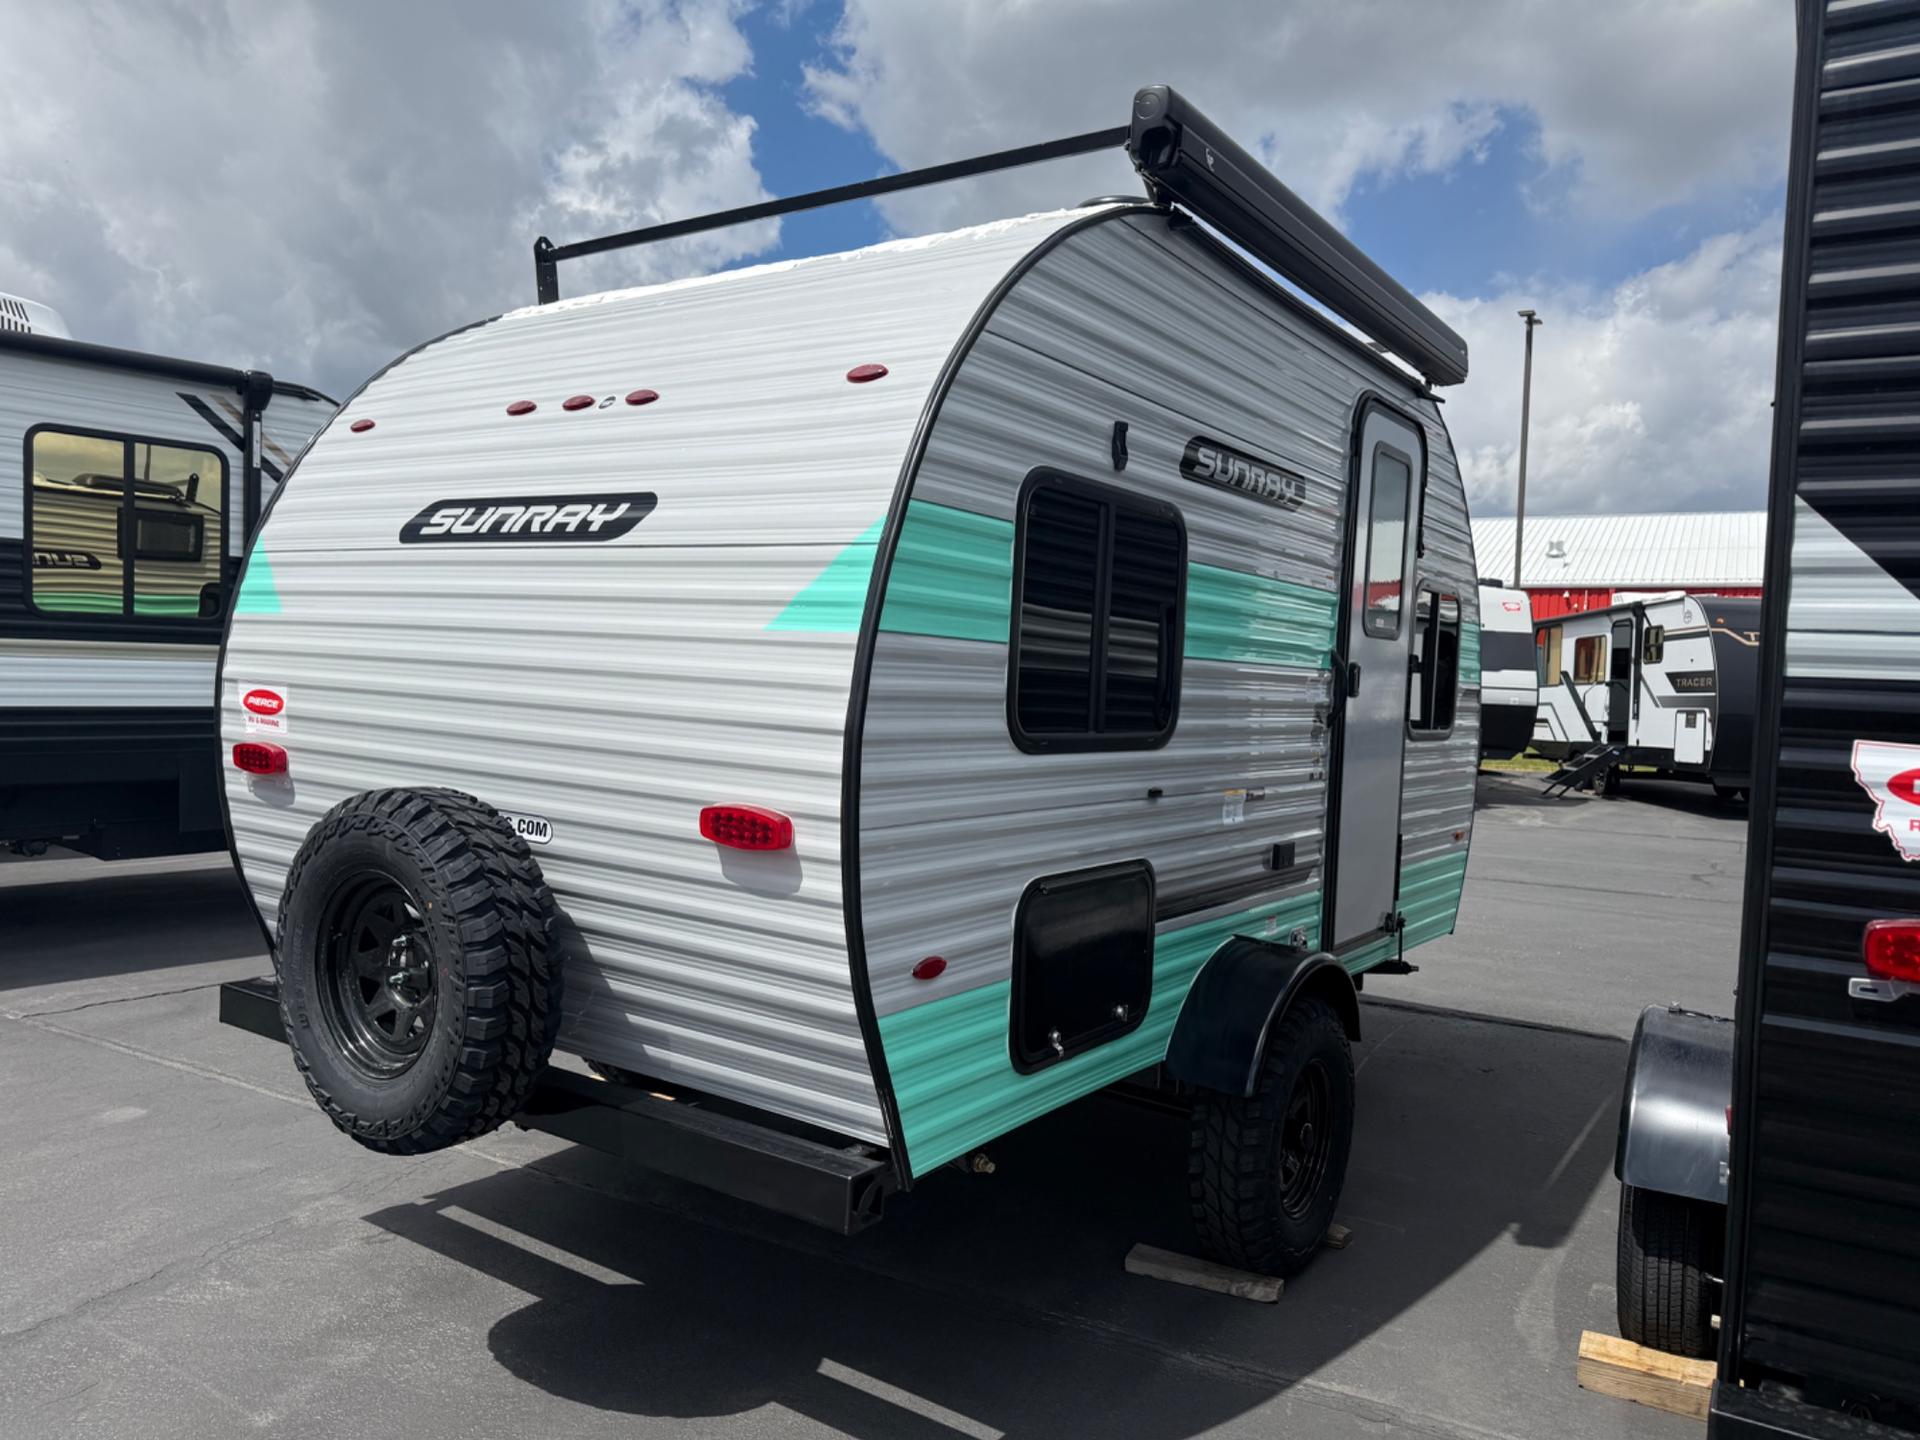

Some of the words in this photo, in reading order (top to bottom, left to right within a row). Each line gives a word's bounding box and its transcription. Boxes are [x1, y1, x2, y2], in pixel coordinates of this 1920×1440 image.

[1193, 446, 1296, 504] SUNRAY
[419, 502, 631, 535] SUNRAY
[1675, 677, 1713, 688] TRACER
